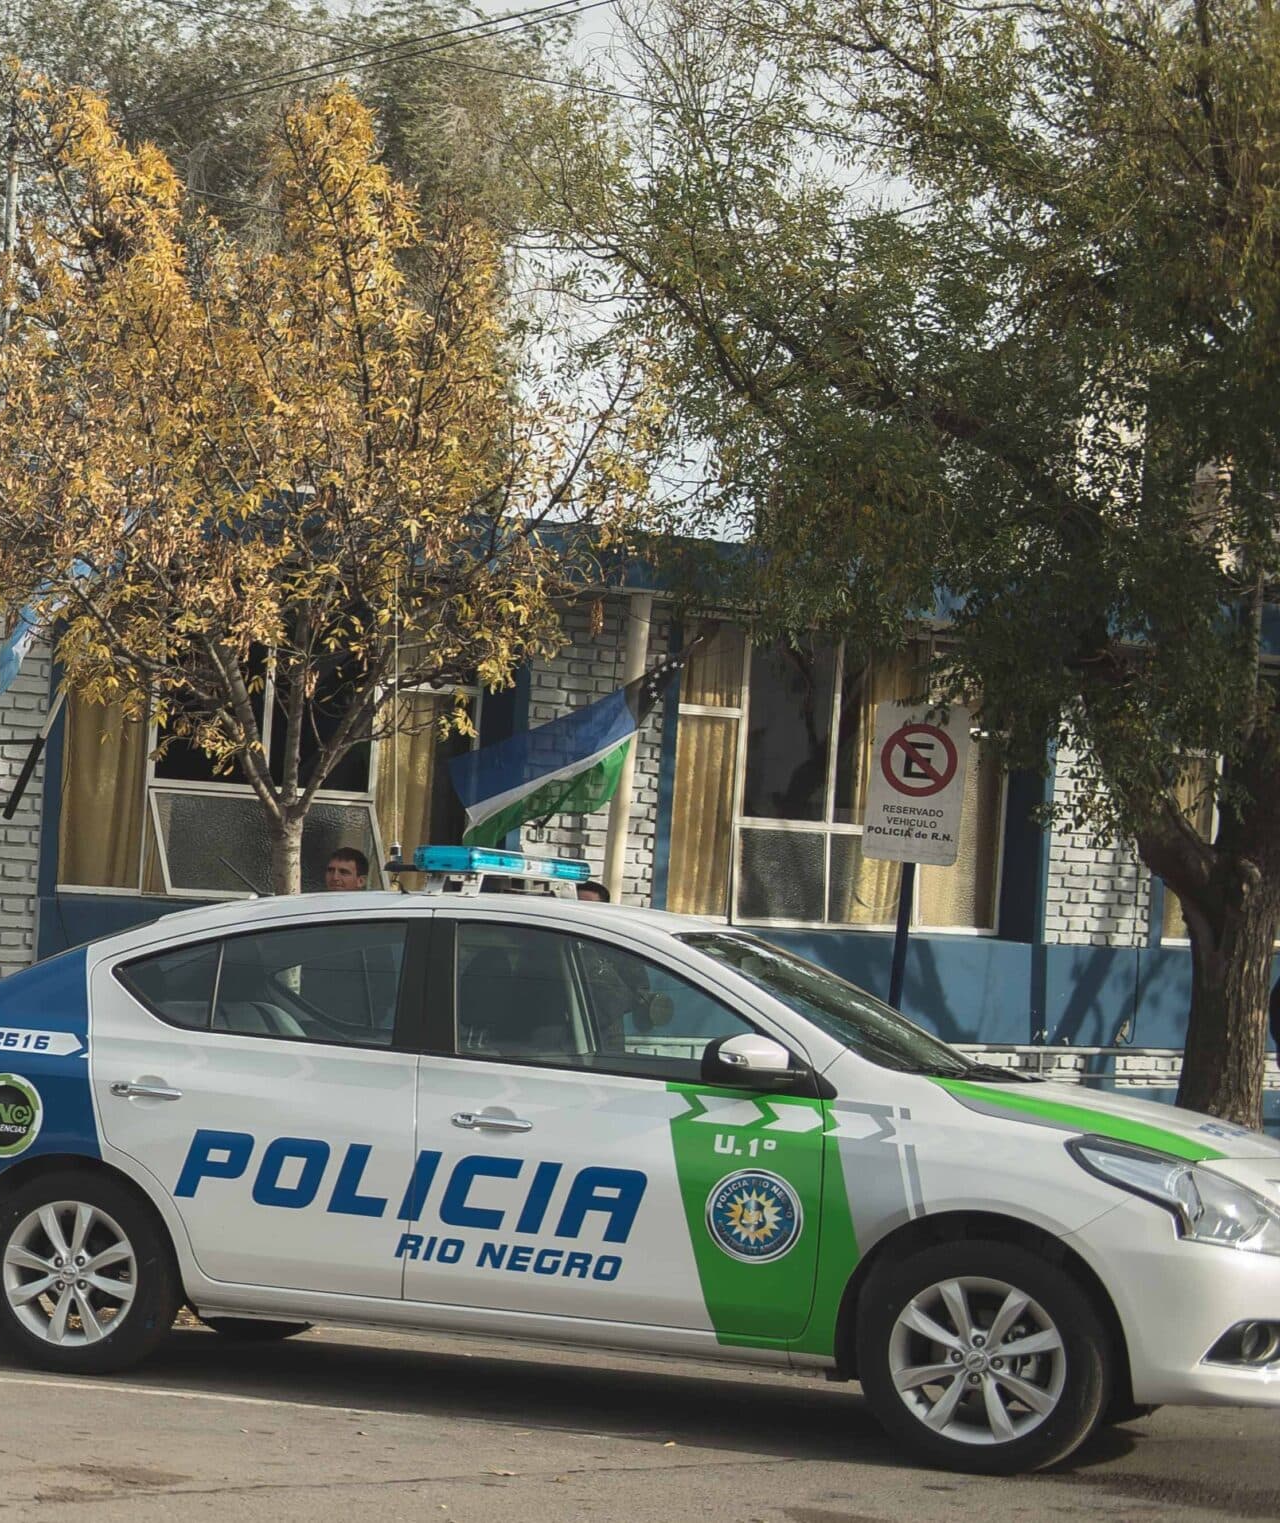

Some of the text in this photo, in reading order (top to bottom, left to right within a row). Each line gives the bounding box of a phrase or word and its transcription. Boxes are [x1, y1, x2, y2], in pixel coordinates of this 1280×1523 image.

[903, 741, 935, 780] E
[882, 804, 944, 818] RESERVADO
[886, 815, 937, 829] VEHICULO
[867, 825, 954, 842] POLICIA de R.N.
[173, 1128, 648, 1244] POLICIA
[715, 1179, 749, 1209] POLICIA
[394, 1232, 623, 1282] RIO NEGRO
